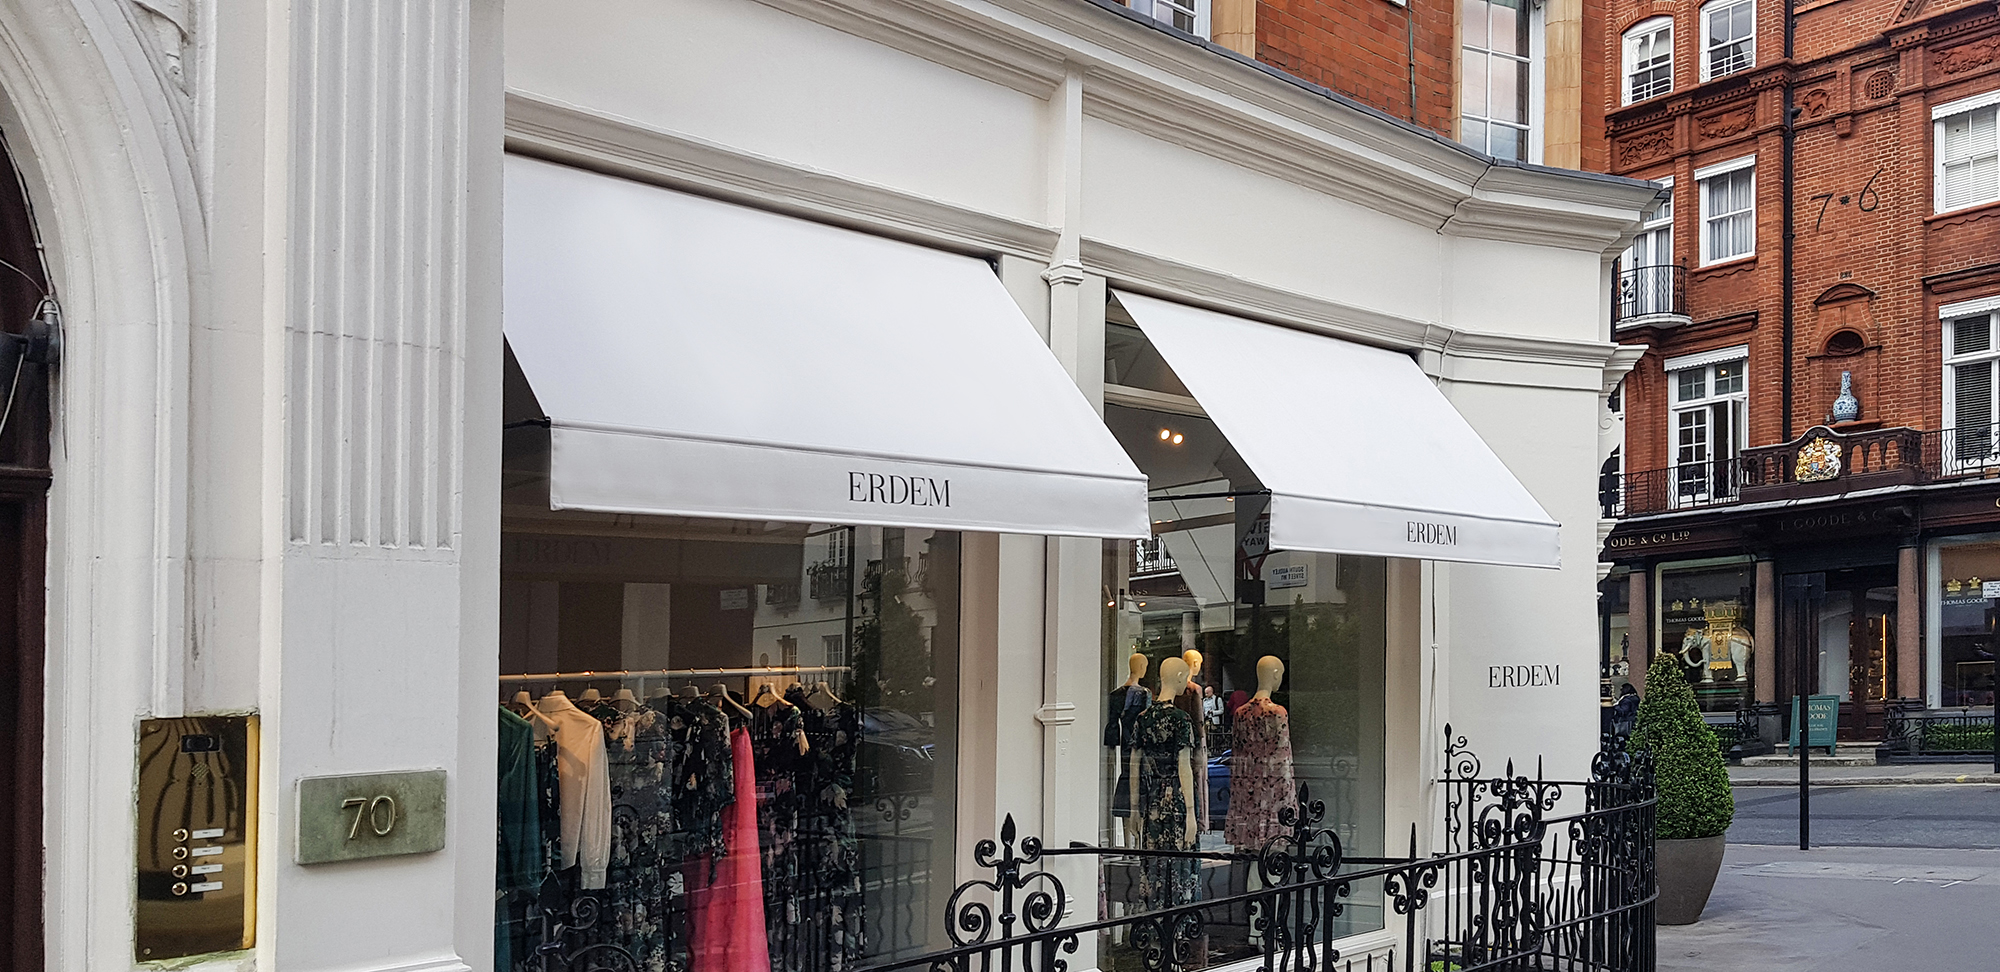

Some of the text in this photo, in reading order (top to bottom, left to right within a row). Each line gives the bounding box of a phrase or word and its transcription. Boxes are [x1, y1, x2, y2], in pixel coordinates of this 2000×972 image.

[848, 471, 951, 507] ERDEM
[1793, 513, 1850, 529] GOODE
[1407, 521, 1457, 546] ERDEM
[1640, 536, 1648, 544] &
[1488, 664, 1560, 688] ERDEM
[340, 796, 396, 840] 70
